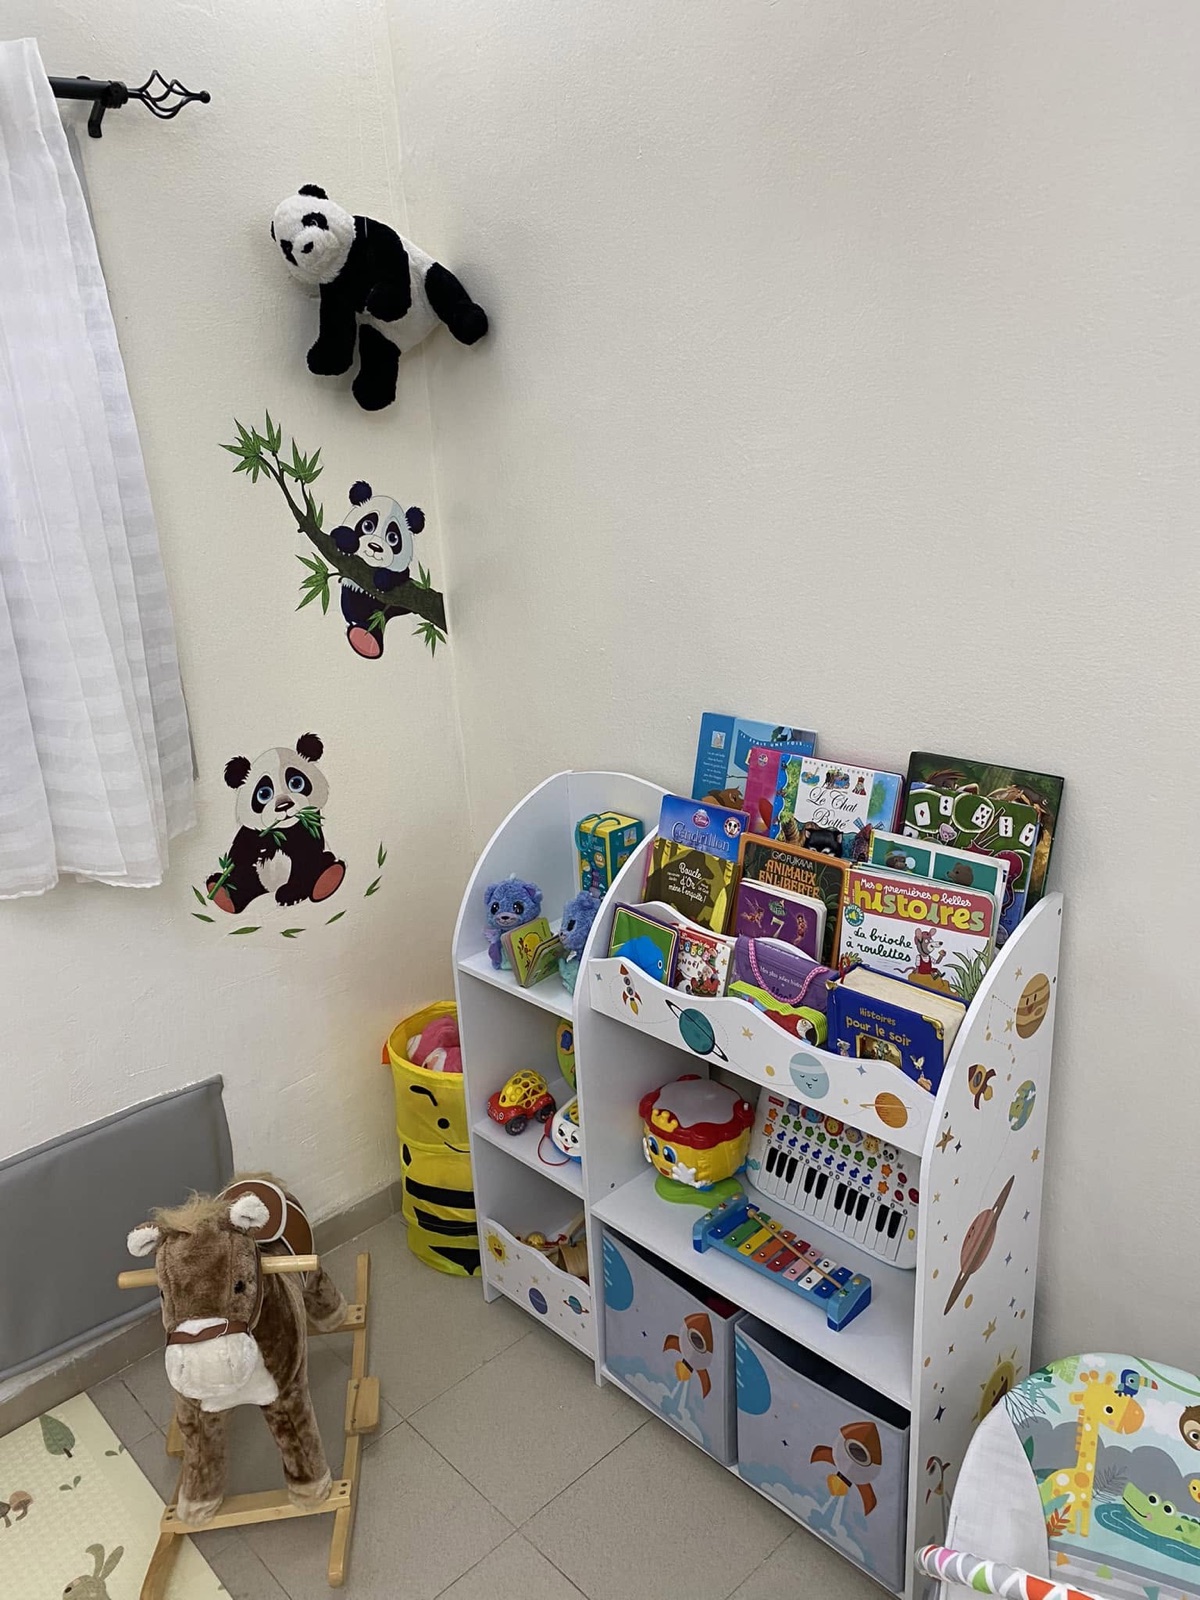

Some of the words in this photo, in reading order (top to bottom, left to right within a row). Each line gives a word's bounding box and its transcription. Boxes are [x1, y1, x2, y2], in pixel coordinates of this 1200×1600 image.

[806, 786, 826, 806] Le
[830, 790, 859, 813] Chat
[811, 807, 850, 830] Botté
[671, 821, 731, 853] Cendrillon
[678, 862, 703, 880] Boucle
[679, 875, 696, 890] d'Or
[766, 859, 817, 886] ANIMAUX
[861, 877, 875, 889] Mes
[884, 884, 932, 901] premières
[941, 893, 972, 907] belles
[854, 880, 985, 932] histoires
[770, 916, 785, 938] 7
[854, 927, 867, 939] La
[869, 927, 913, 949] brioche
[846, 936, 854, 948] à
[857, 941, 911, 963] roulettes
[858, 1006, 897, 1026] Histoires
[845, 1015, 872, 1033] pour
[875, 1024, 886, 1037] le
[889, 1030, 912, 1047] soir
